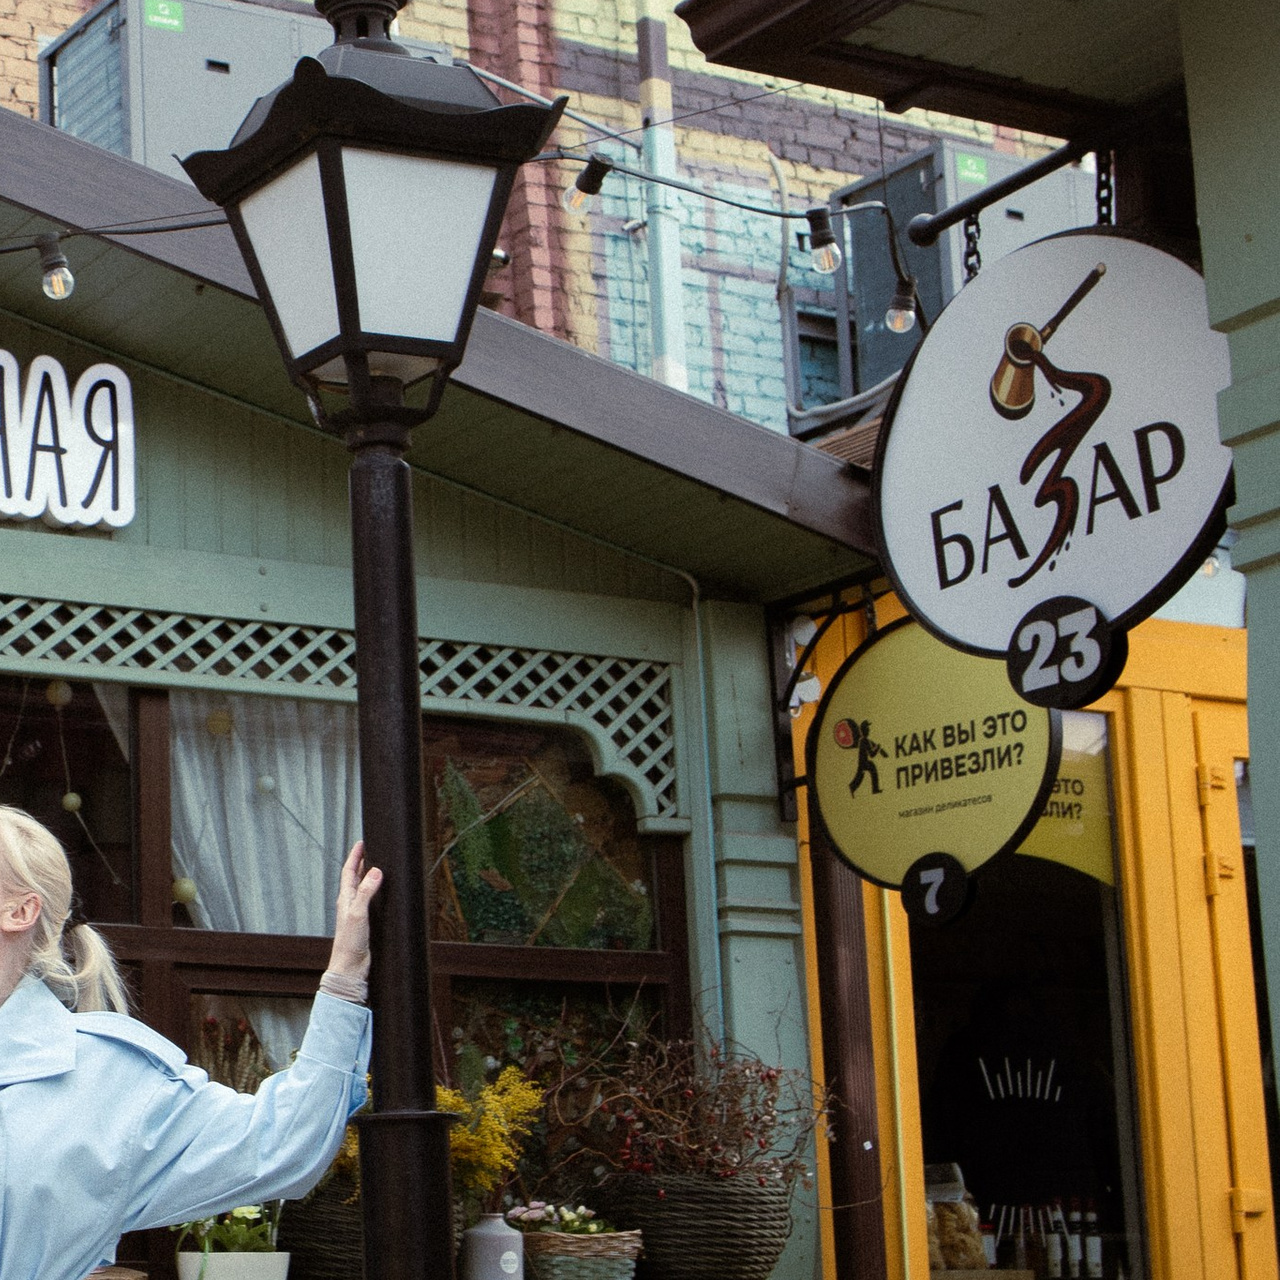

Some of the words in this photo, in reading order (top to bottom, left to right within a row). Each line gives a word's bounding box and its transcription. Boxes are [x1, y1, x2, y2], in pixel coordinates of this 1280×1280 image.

[930, 371, 1186, 591] БАЗАР
[1017, 606, 1102, 694] 23
[894, 729, 937, 759] КАК
[942, 720, 976, 748] ВЫ
[982, 709, 1028, 739] ЭТО
[895, 742, 1024, 790] ПРИВЕЗЛИ?
[920, 867, 944, 914] 7
